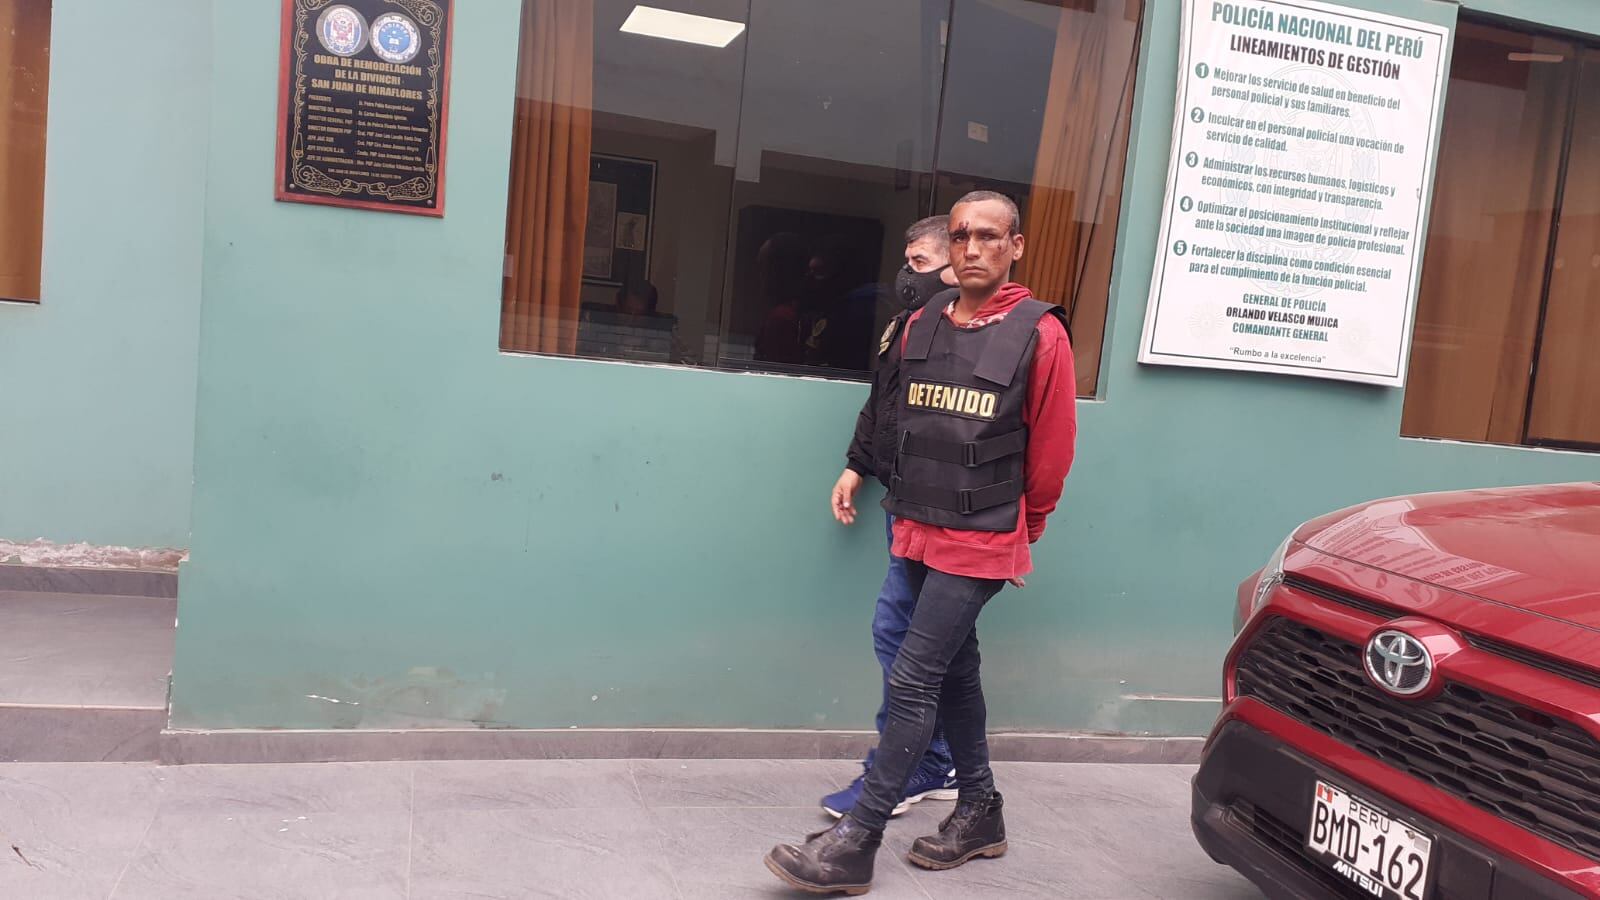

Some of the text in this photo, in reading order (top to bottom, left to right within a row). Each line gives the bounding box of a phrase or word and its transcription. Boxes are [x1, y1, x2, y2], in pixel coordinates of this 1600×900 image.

[1212, 1, 1424, 59] POLICÍA NACIONAL DEL PERÚ
[313, 54, 423, 76] OBRA DE REMODELACIÓN
[1230, 34, 1401, 80] LINEAMIENTOS DE GESTIÓN
[311, 78, 423, 100] SAN JUAN DE MIRAFLORES
[335, 69, 401, 86] DE LA DIVINCRI
[1213, 67, 1247, 84] Mejorar
[1248, 73, 1262, 87] los
[1263, 76, 1298, 92] servicio
[1299, 82, 1310, 95] de
[1311, 84, 1335, 99] salud
[1335, 90, 1346, 101] en
[1347, 90, 1386, 108] beneficio
[1387, 97, 1401, 111] del
[1211, 85, 1351, 118] personal policial y sus familiares.
[1206, 129, 1288, 152] servicio de calidad.
[1208, 111, 1245, 129] Inculcar
[1245, 119, 1257, 131] en
[1258, 120, 1267, 132] el
[1267, 122, 1305, 138] personal
[1306, 128, 1338, 144] policial
[1339, 134, 1355, 147] una
[1394, 142, 1405, 154] de
[1203, 157, 1254, 175] Administrar
[1255, 164, 1269, 177] los
[1269, 168, 1307, 183] recursos
[1390, 186, 1396, 198] y
[1256, 182, 1272, 195] con
[1273, 183, 1318, 201] integridad
[1318, 190, 1324, 203] y
[1324, 192, 1384, 210] transparencia.
[1195, 218, 1215, 230] ante
[1215, 219, 1225, 232] la
[1225, 222, 1265, 237] sociedad
[1265, 227, 1282, 239] una
[1283, 228, 1315, 243] imagen
[1316, 232, 1327, 245] de
[1357, 240, 1406, 256] profesional.
[1197, 200, 1238, 217] Optimizar
[1239, 206, 1248, 218] el
[1249, 208, 1320, 228] posicionamiento
[1373, 224, 1380, 237] y
[1380, 226, 1410, 242] reflejar
[1189, 261, 1368, 293] para el cumplimiento de la función policial.
[1191, 243, 1236, 261] Fortalecer
[1237, 248, 1245, 262] la
[1246, 249, 1289, 266] disciplina
[1289, 256, 1314, 270] como
[1314, 258, 1356, 276] condición
[1356, 265, 1392, 280] esencial
[1226, 306, 1340, 329] ORLANDO VELASCO MUJICA
[1243, 293, 1327, 313] GENERAL DE POLICÍA
[1232, 321, 1330, 342] COMANDANTE GENERAL
[1264, 350, 1270, 359] a
[1271, 350, 1279, 360] la
[908, 383, 996, 418] DETENIDO
[1349, 801, 1390, 834] PERU
[1313, 800, 1424, 900] BMD-162
[1332, 860, 1384, 898] MITSUI
